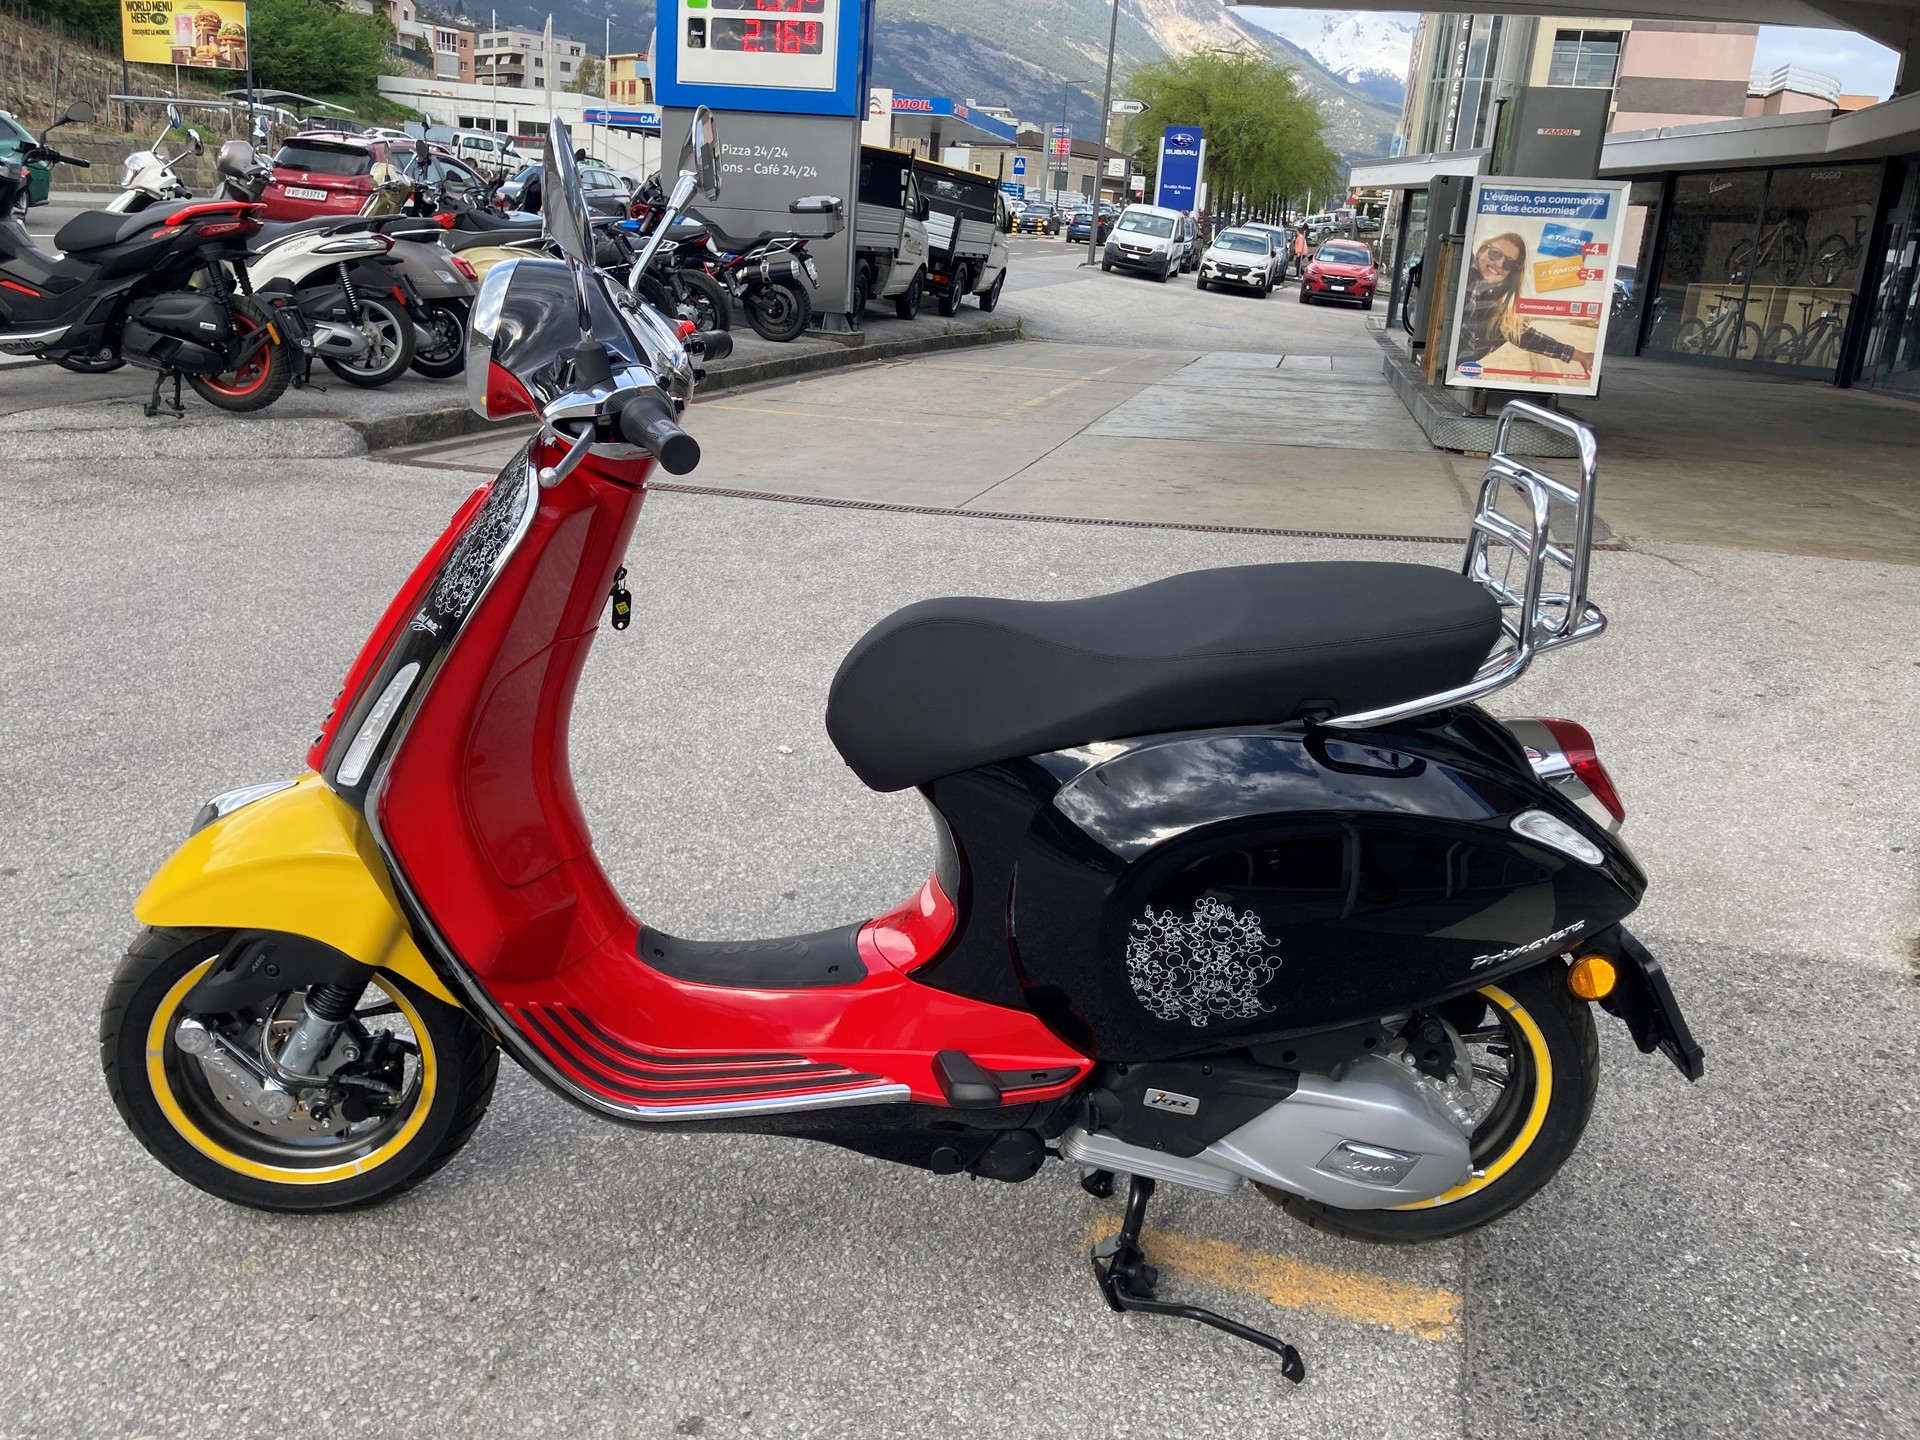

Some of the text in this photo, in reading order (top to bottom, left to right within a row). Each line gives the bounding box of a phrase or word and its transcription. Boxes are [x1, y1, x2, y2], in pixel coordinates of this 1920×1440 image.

[125, 1, 152, 12] WORLD
[152, 1, 173, 12] MENU
[131, 13, 151, 23] HEIST
[1444, 41, 1467, 144] GÉNÉRALE
[891, 98, 933, 111] AMOIL
[640, 115, 659, 124] CAR
[1542, 128, 1576, 136] TAMOIL
[721, 144, 789, 160] Pizza 24/24
[1165, 148, 1198, 156] SUBARU
[753, 163, 779, 175] Café
[782, 165, 818, 179] 24/24
[1810, 171, 1842, 180] PIAGGIO
[1441, 175, 1449, 186] 4
[1484, 191, 1605, 206] L'évasion, ça commence
[1482, 203, 1580, 215] par des économies!
[1519, 303, 1555, 312] Commander
[1470, 920, 1585, 970] Primavera
[252, 954, 265, 973] ABS
